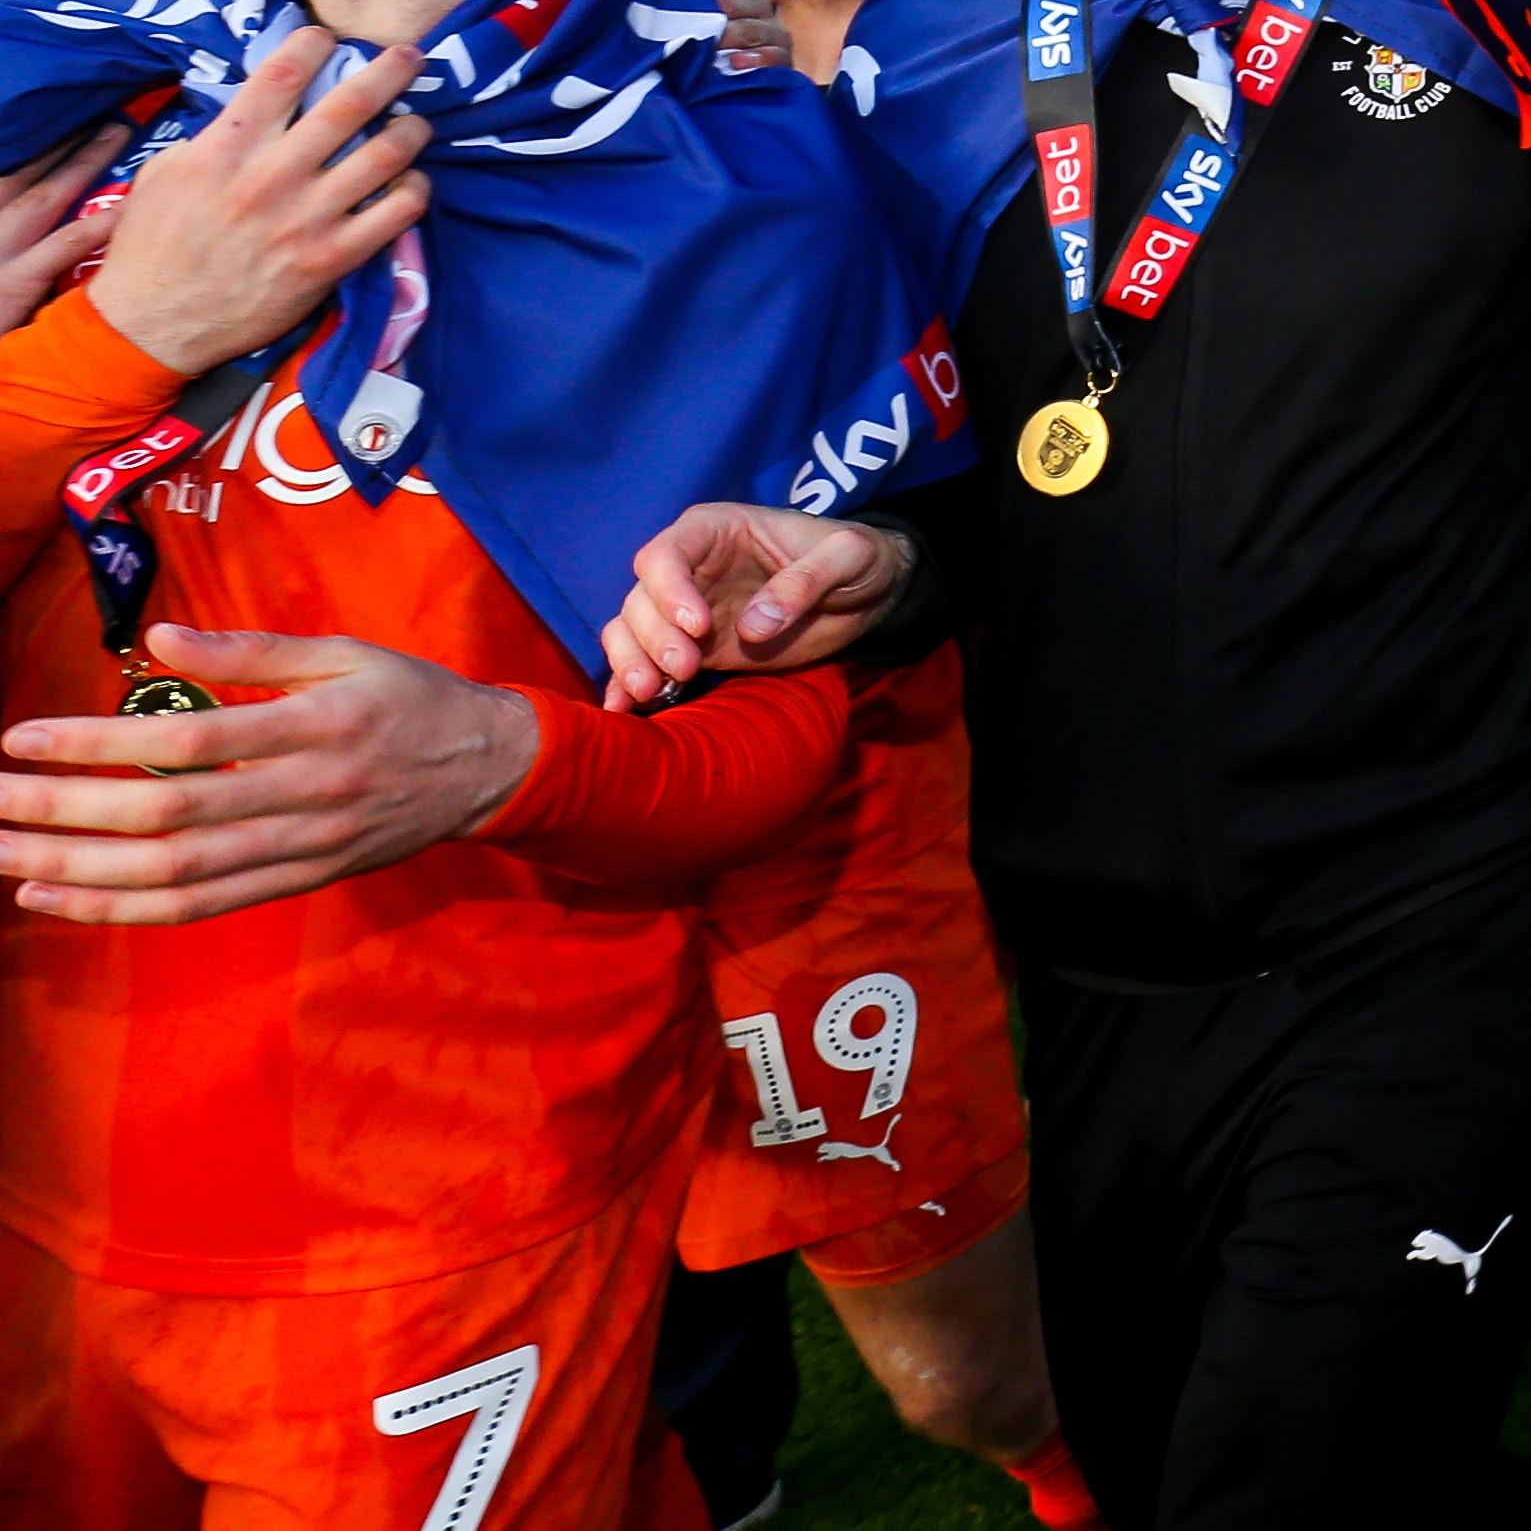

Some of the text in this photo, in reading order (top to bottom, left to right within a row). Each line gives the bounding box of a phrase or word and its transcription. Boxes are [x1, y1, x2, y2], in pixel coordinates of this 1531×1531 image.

[1235, 14, 1304, 92] bet
[1340, 80, 1453, 121] FOOTBALL CLUB
[1047, 135, 1089, 302] sky bet
[1120, 148, 1223, 308] sky bet
[65, 428, 185, 503] bet
[788, 391, 911, 516] sky
[722, 972, 920, 1147] 19
[372, 1344, 541, 1531] 7
